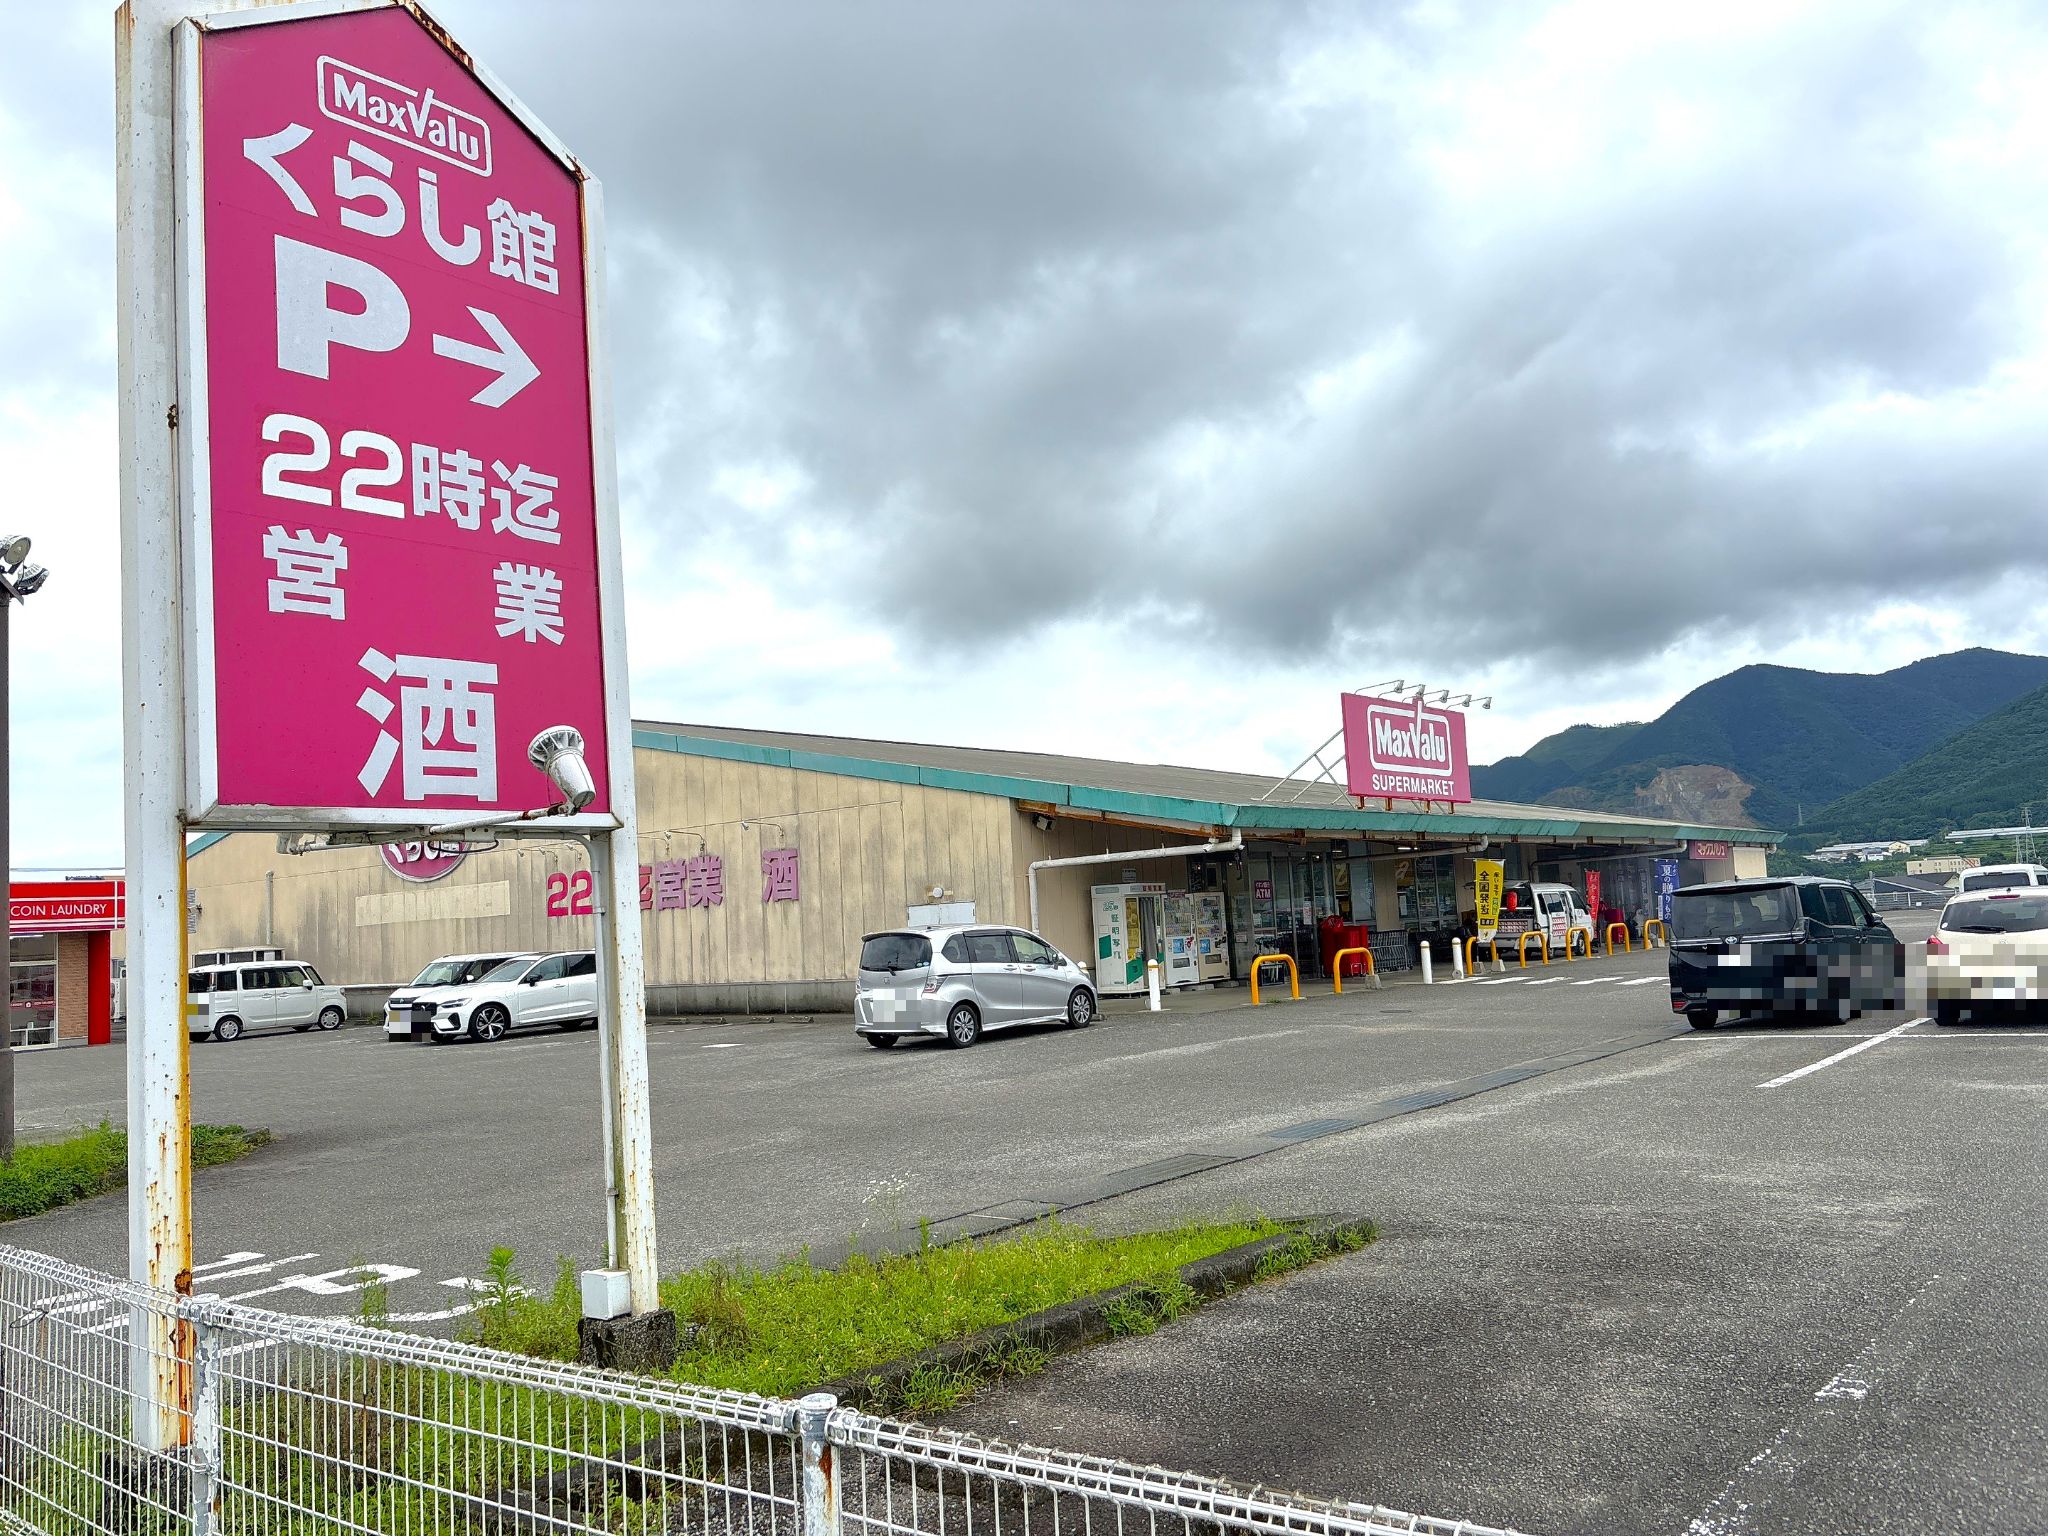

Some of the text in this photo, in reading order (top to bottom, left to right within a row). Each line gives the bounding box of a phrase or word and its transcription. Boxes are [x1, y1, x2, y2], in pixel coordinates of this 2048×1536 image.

[333, 72, 480, 162] MaxValu
[243, 122, 560, 295] くらし館
[274, 234, 411, 380] P
[262, 413, 562, 545] 22時迄
[356, 646, 499, 802] 酒
[1374, 700, 1446, 763] MaxValu
[1372, 774, 1455, 796] SUPERMARKET
[10, 904, 107, 916] COIN LAUNDRY
[762, 848, 799, 903] 酒
[1256, 889, 1271, 899] ATM
